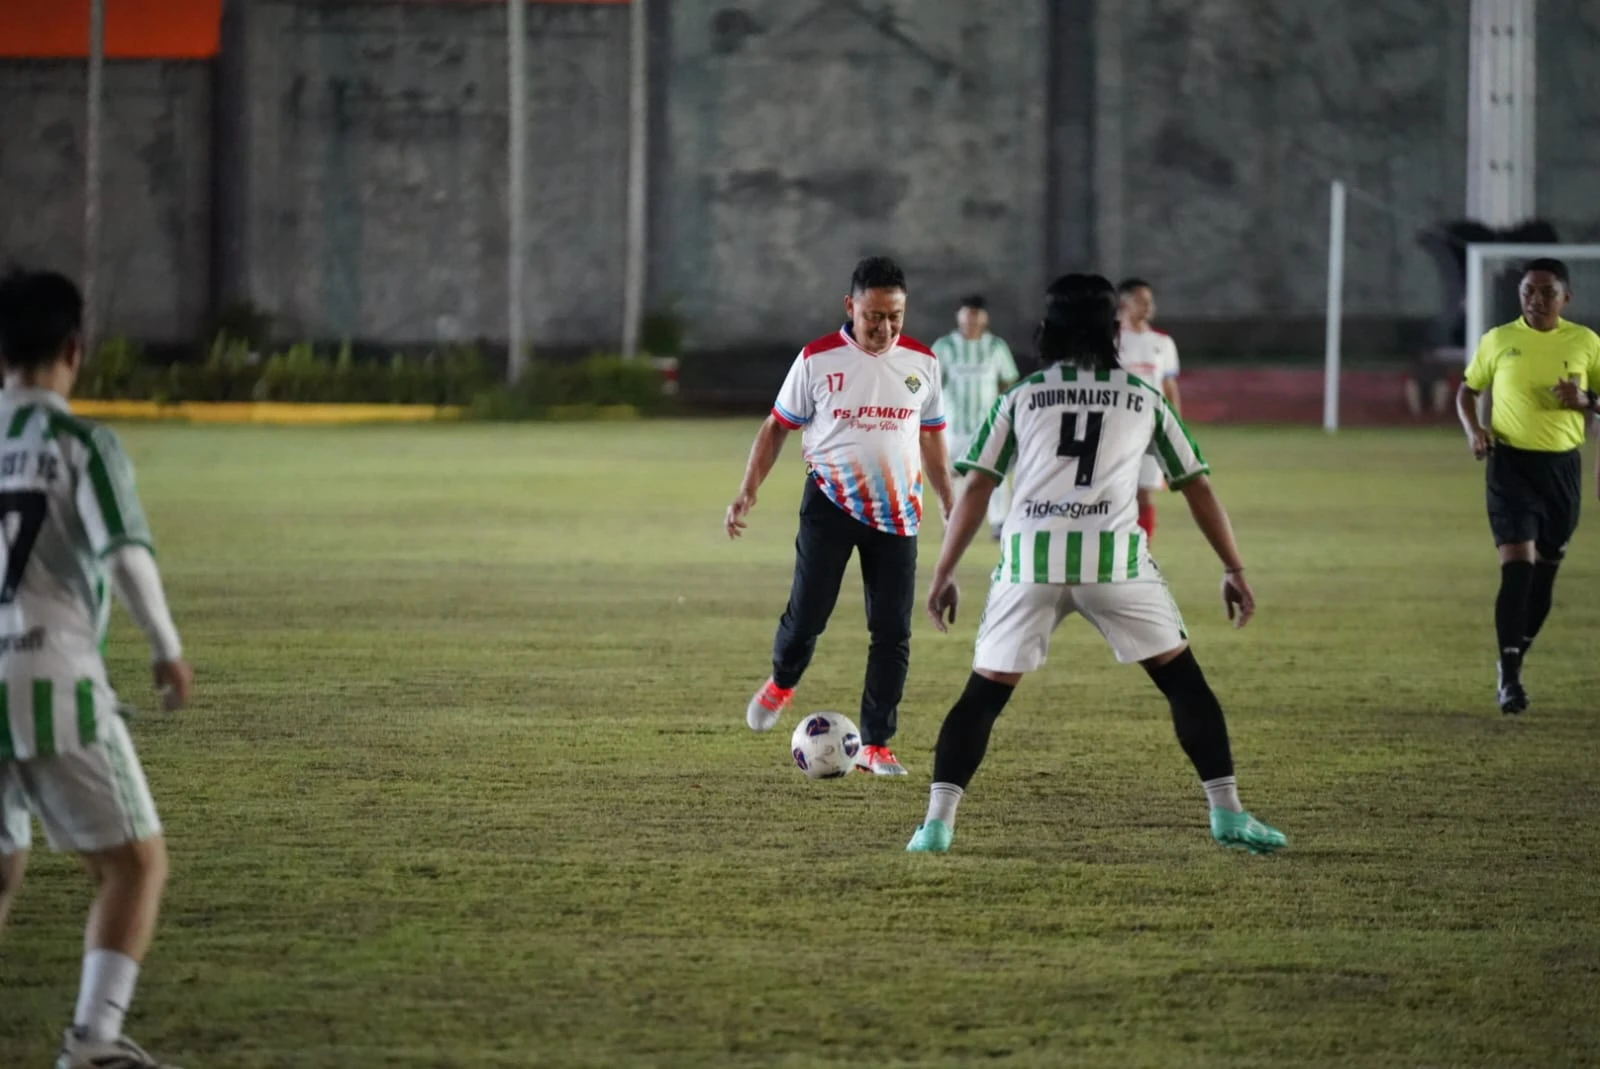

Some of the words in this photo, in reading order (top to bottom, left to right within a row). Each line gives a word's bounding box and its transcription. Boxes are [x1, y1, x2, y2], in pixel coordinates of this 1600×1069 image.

[826, 372, 845, 392] 17
[1028, 389, 1120, 411] JOURNALIST
[1126, 393, 1144, 412] FC
[1056, 411, 1103, 486] 4
